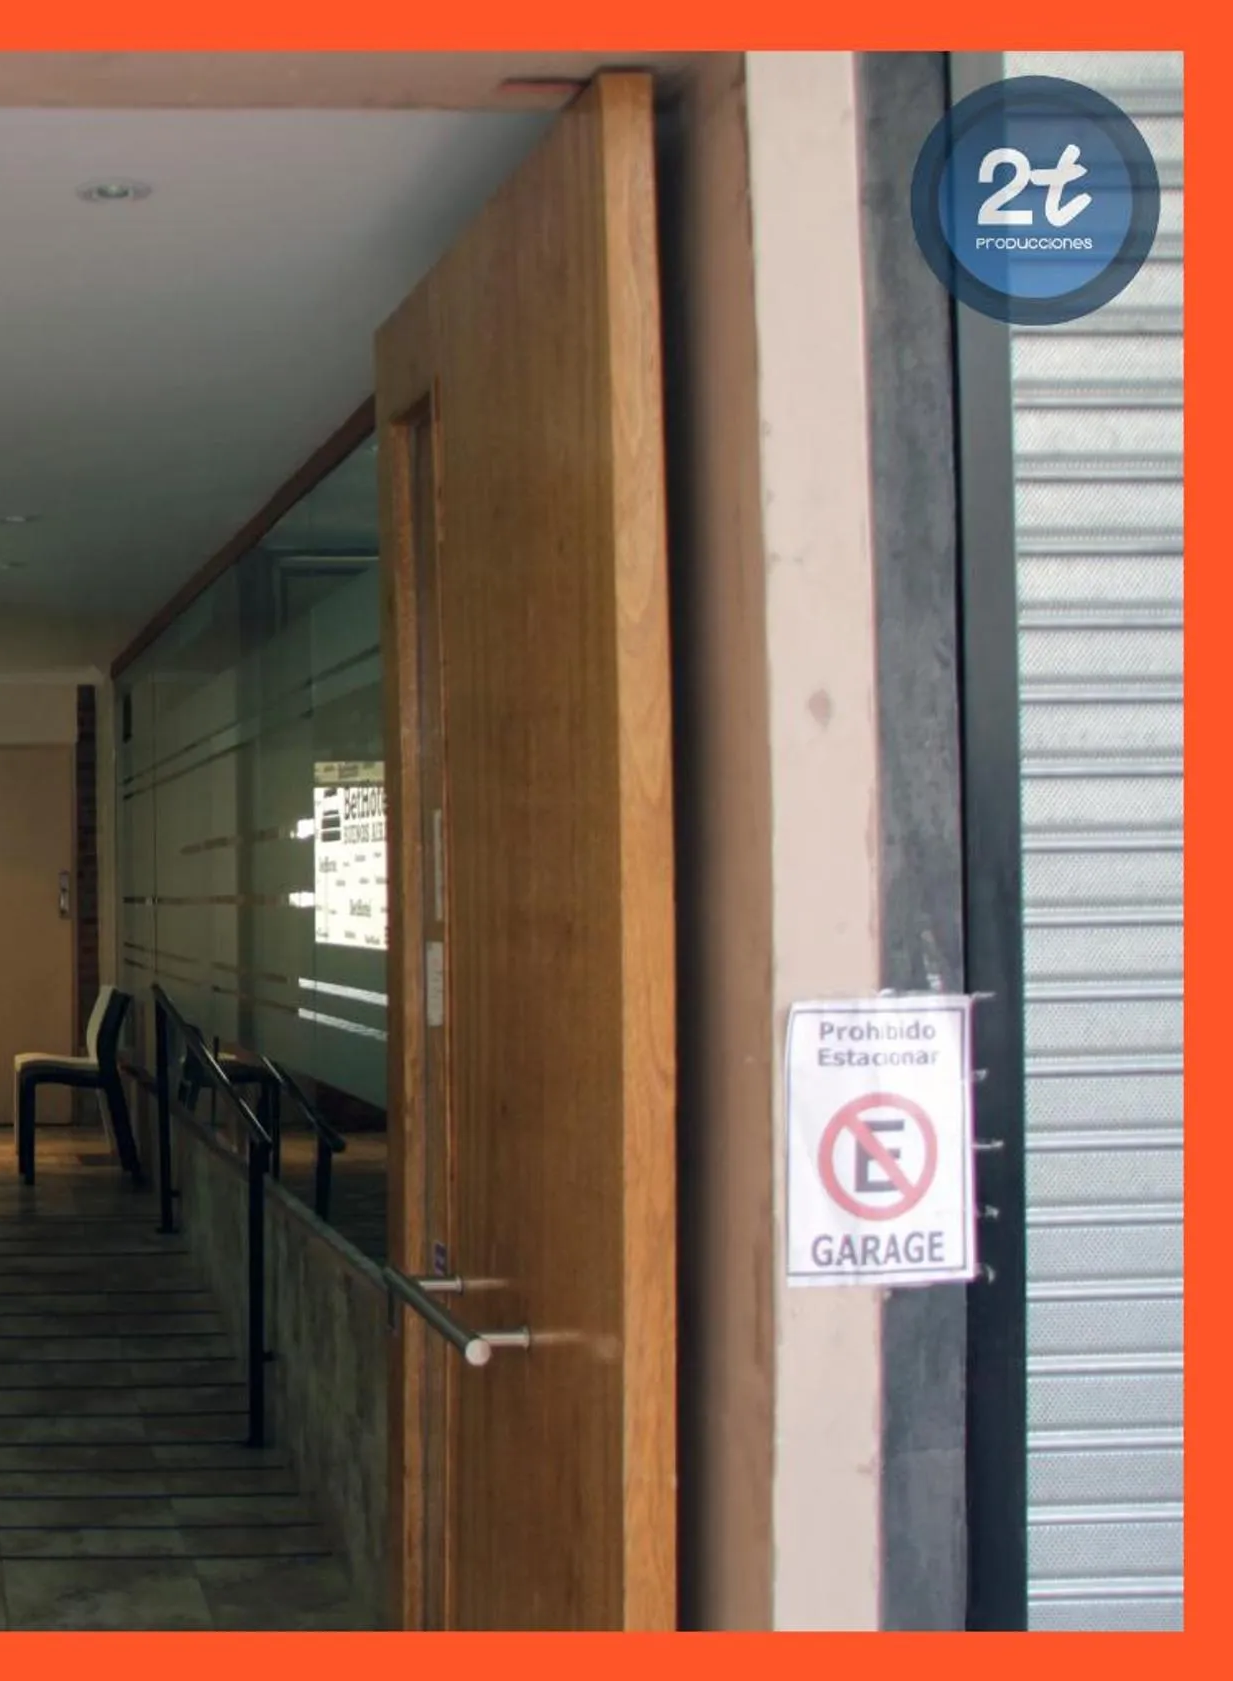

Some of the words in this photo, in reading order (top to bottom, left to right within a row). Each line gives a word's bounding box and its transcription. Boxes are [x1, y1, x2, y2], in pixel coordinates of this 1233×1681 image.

[819, 1021, 936, 1042] Prohibido
[817, 1047, 939, 1067] Estacionar
[811, 1231, 945, 1267] GARAGE
